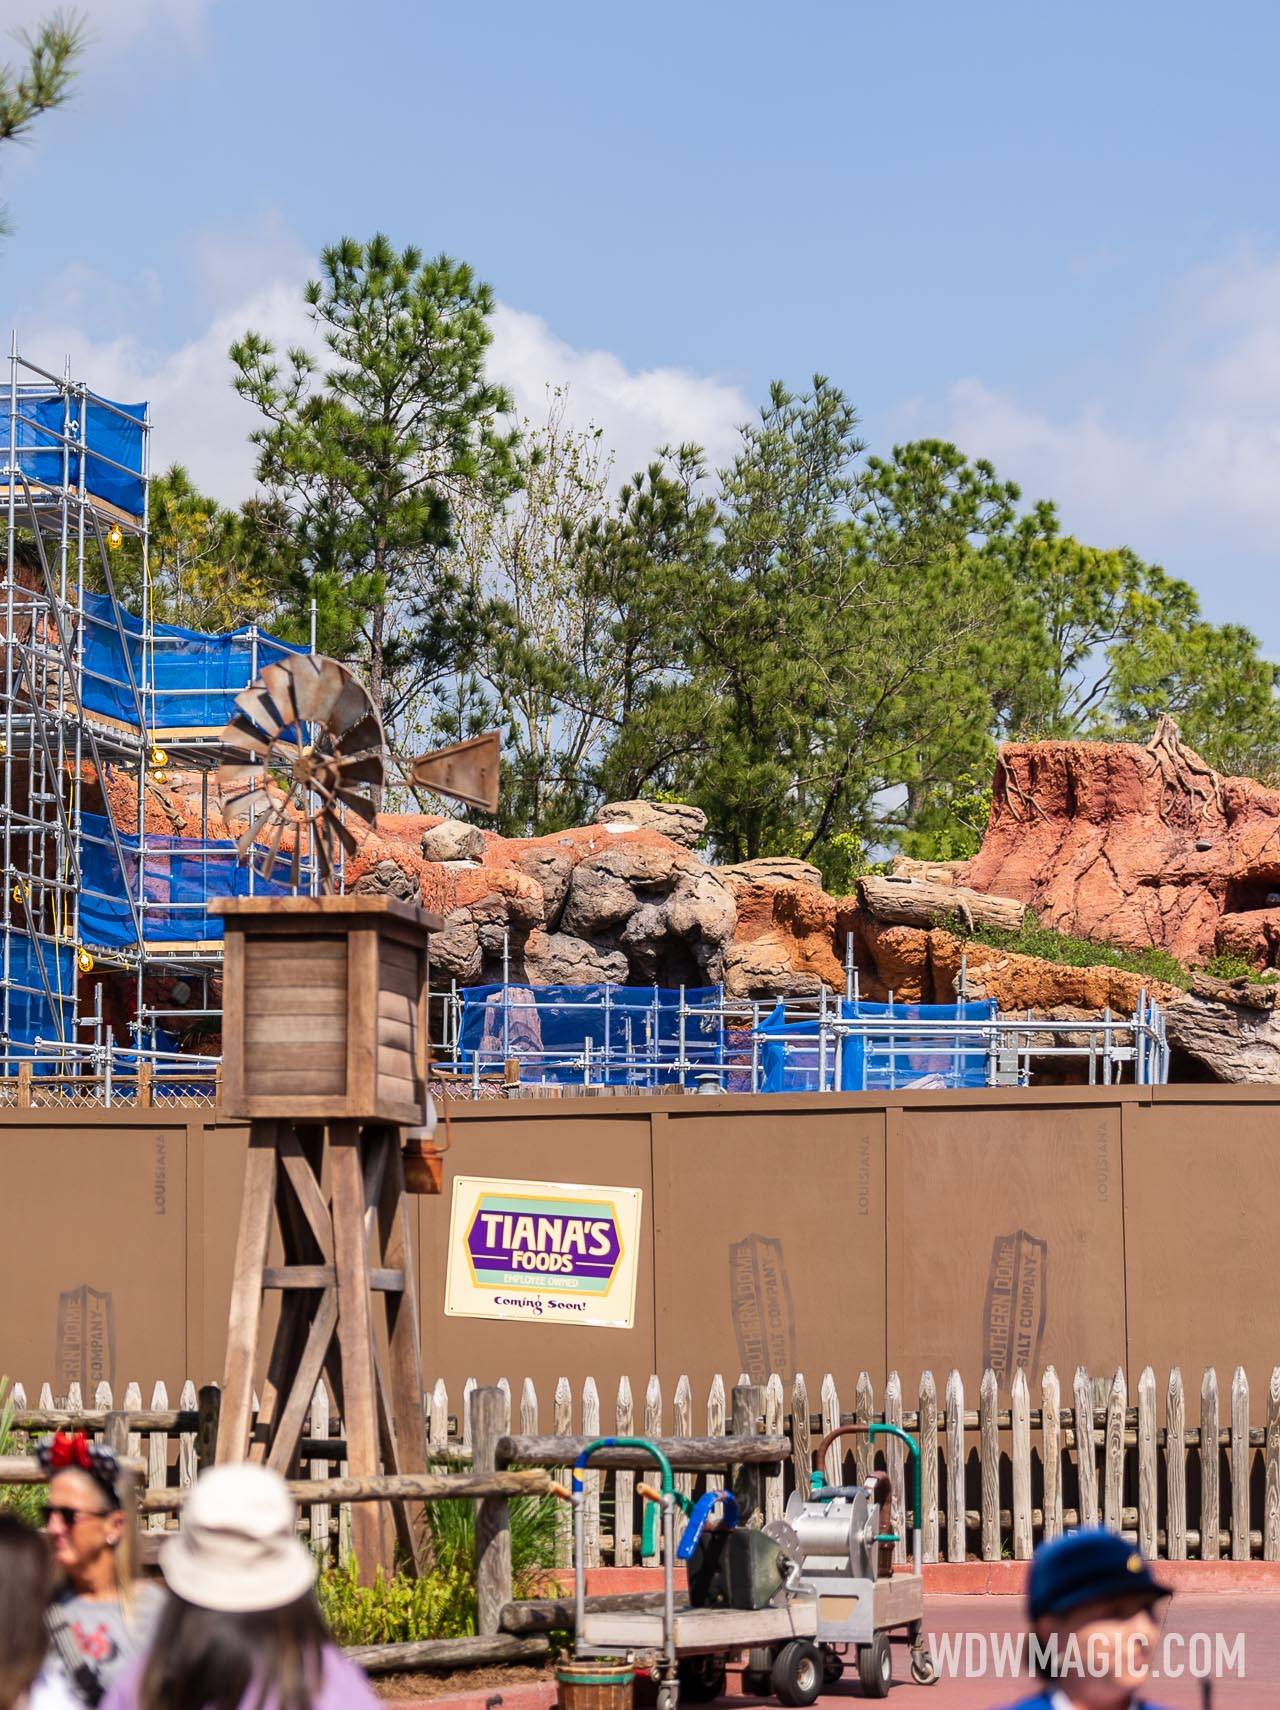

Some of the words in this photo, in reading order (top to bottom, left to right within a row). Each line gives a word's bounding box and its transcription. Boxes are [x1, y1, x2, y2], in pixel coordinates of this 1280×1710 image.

[154, 1135, 166, 1216] LOUISIANA
[857, 1136, 869, 1216] LOUISIANA
[1096, 1121, 1109, 1202] LOUISIANA
[481, 1214, 611, 1256] TIANA'S
[511, 1251, 573, 1273] FOODS
[494, 1295, 543, 1315] Coming
[547, 1299, 587, 1312] Soon!
[503, 1274, 545, 1286] EMPLOYEE
[548, 1277, 578, 1288] OWNED
[762, 1257, 782, 1329] COMPANY
[1019, 1256, 1037, 1329] COMPANY
[90, 1311, 103, 1381] COMPANY
[1016, 1332, 1031, 1367] SALT
